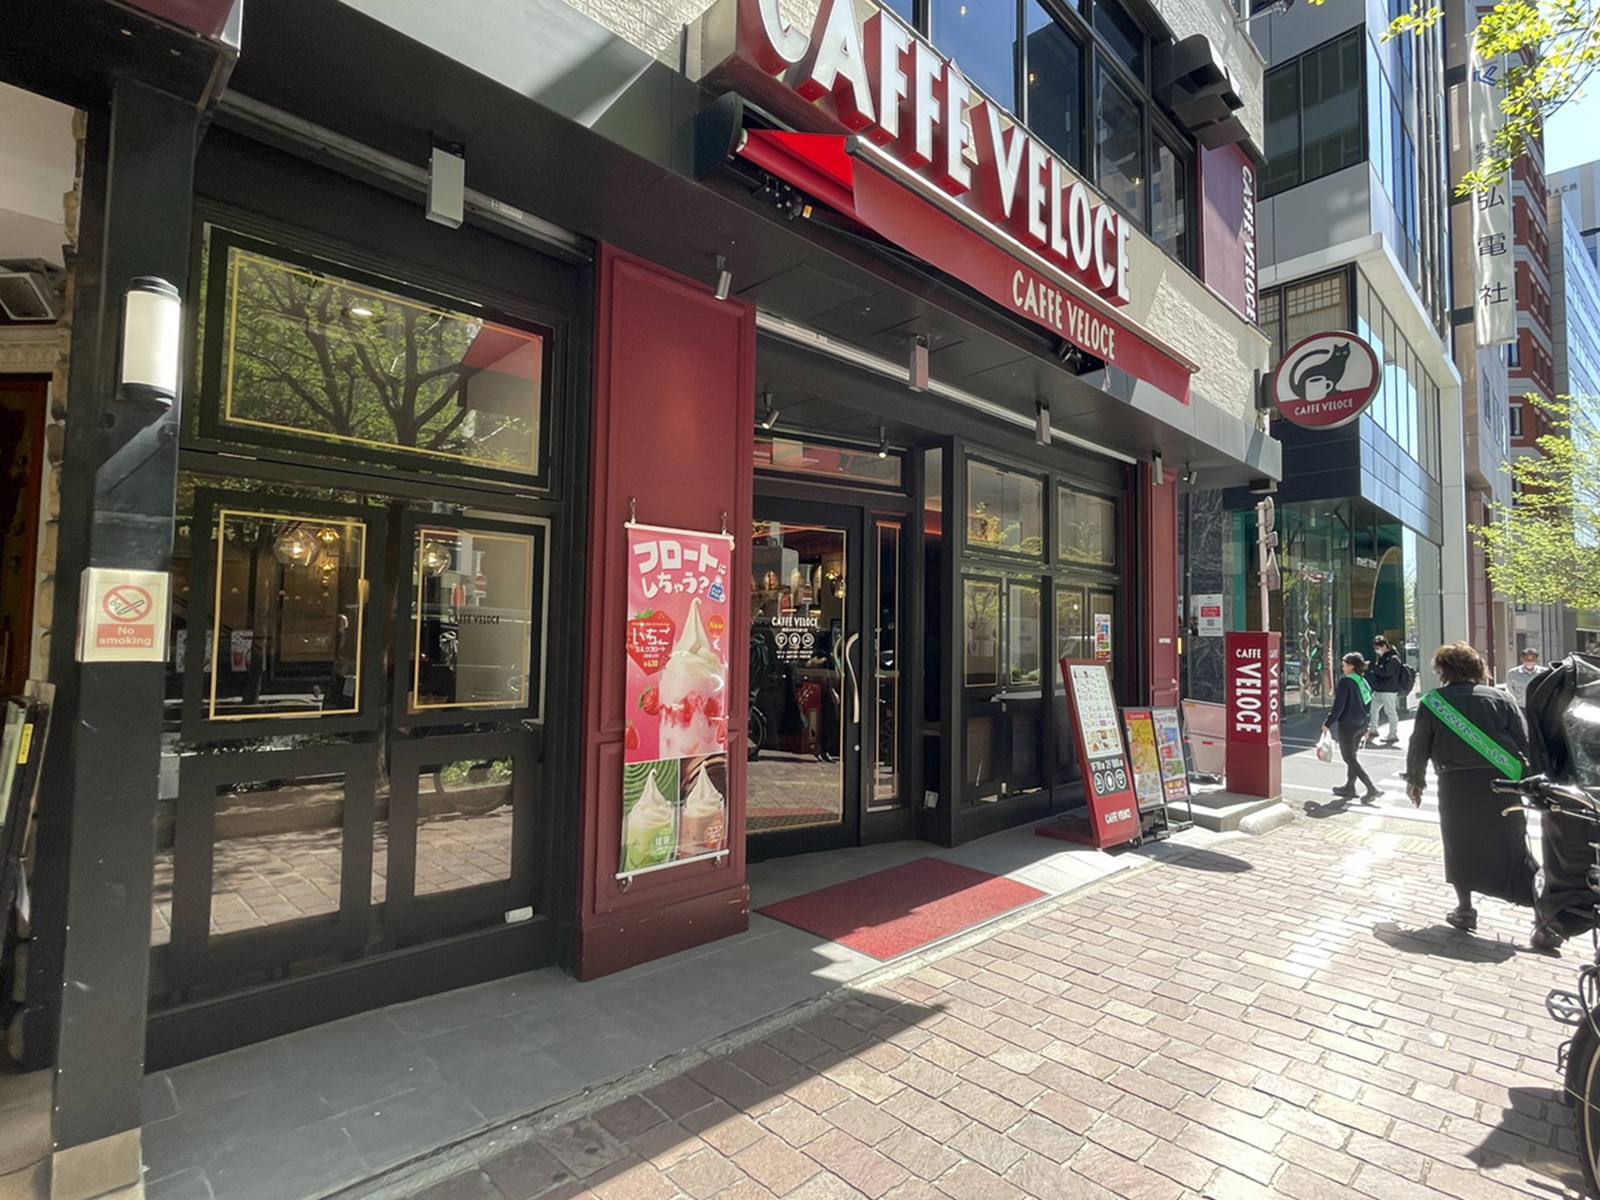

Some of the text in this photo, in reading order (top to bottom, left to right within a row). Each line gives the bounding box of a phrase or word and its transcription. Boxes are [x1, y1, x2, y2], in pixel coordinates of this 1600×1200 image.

[984, 100, 1132, 302] VELOCE
[1477, 185, 1509, 306] 弘電社
[1244, 241, 1256, 322] VELOCE
[1066, 300, 1115, 360] VELOCE
[1321, 398, 1353, 411] VELOCE
[633, 541, 727, 575] フロートに
[641, 571, 710, 598] しちゃう？
[117, 626, 135, 635] No
[473, 614, 500, 625] VELOCE
[793, 616, 818, 627] VELOCE
[98, 637, 152, 647] smoking
[632, 627, 671, 645] いちご
[1236, 648, 1262, 658] CAFFE
[1236, 662, 1262, 734] VELOCE
[1269, 663, 1279, 733] VELOCE
